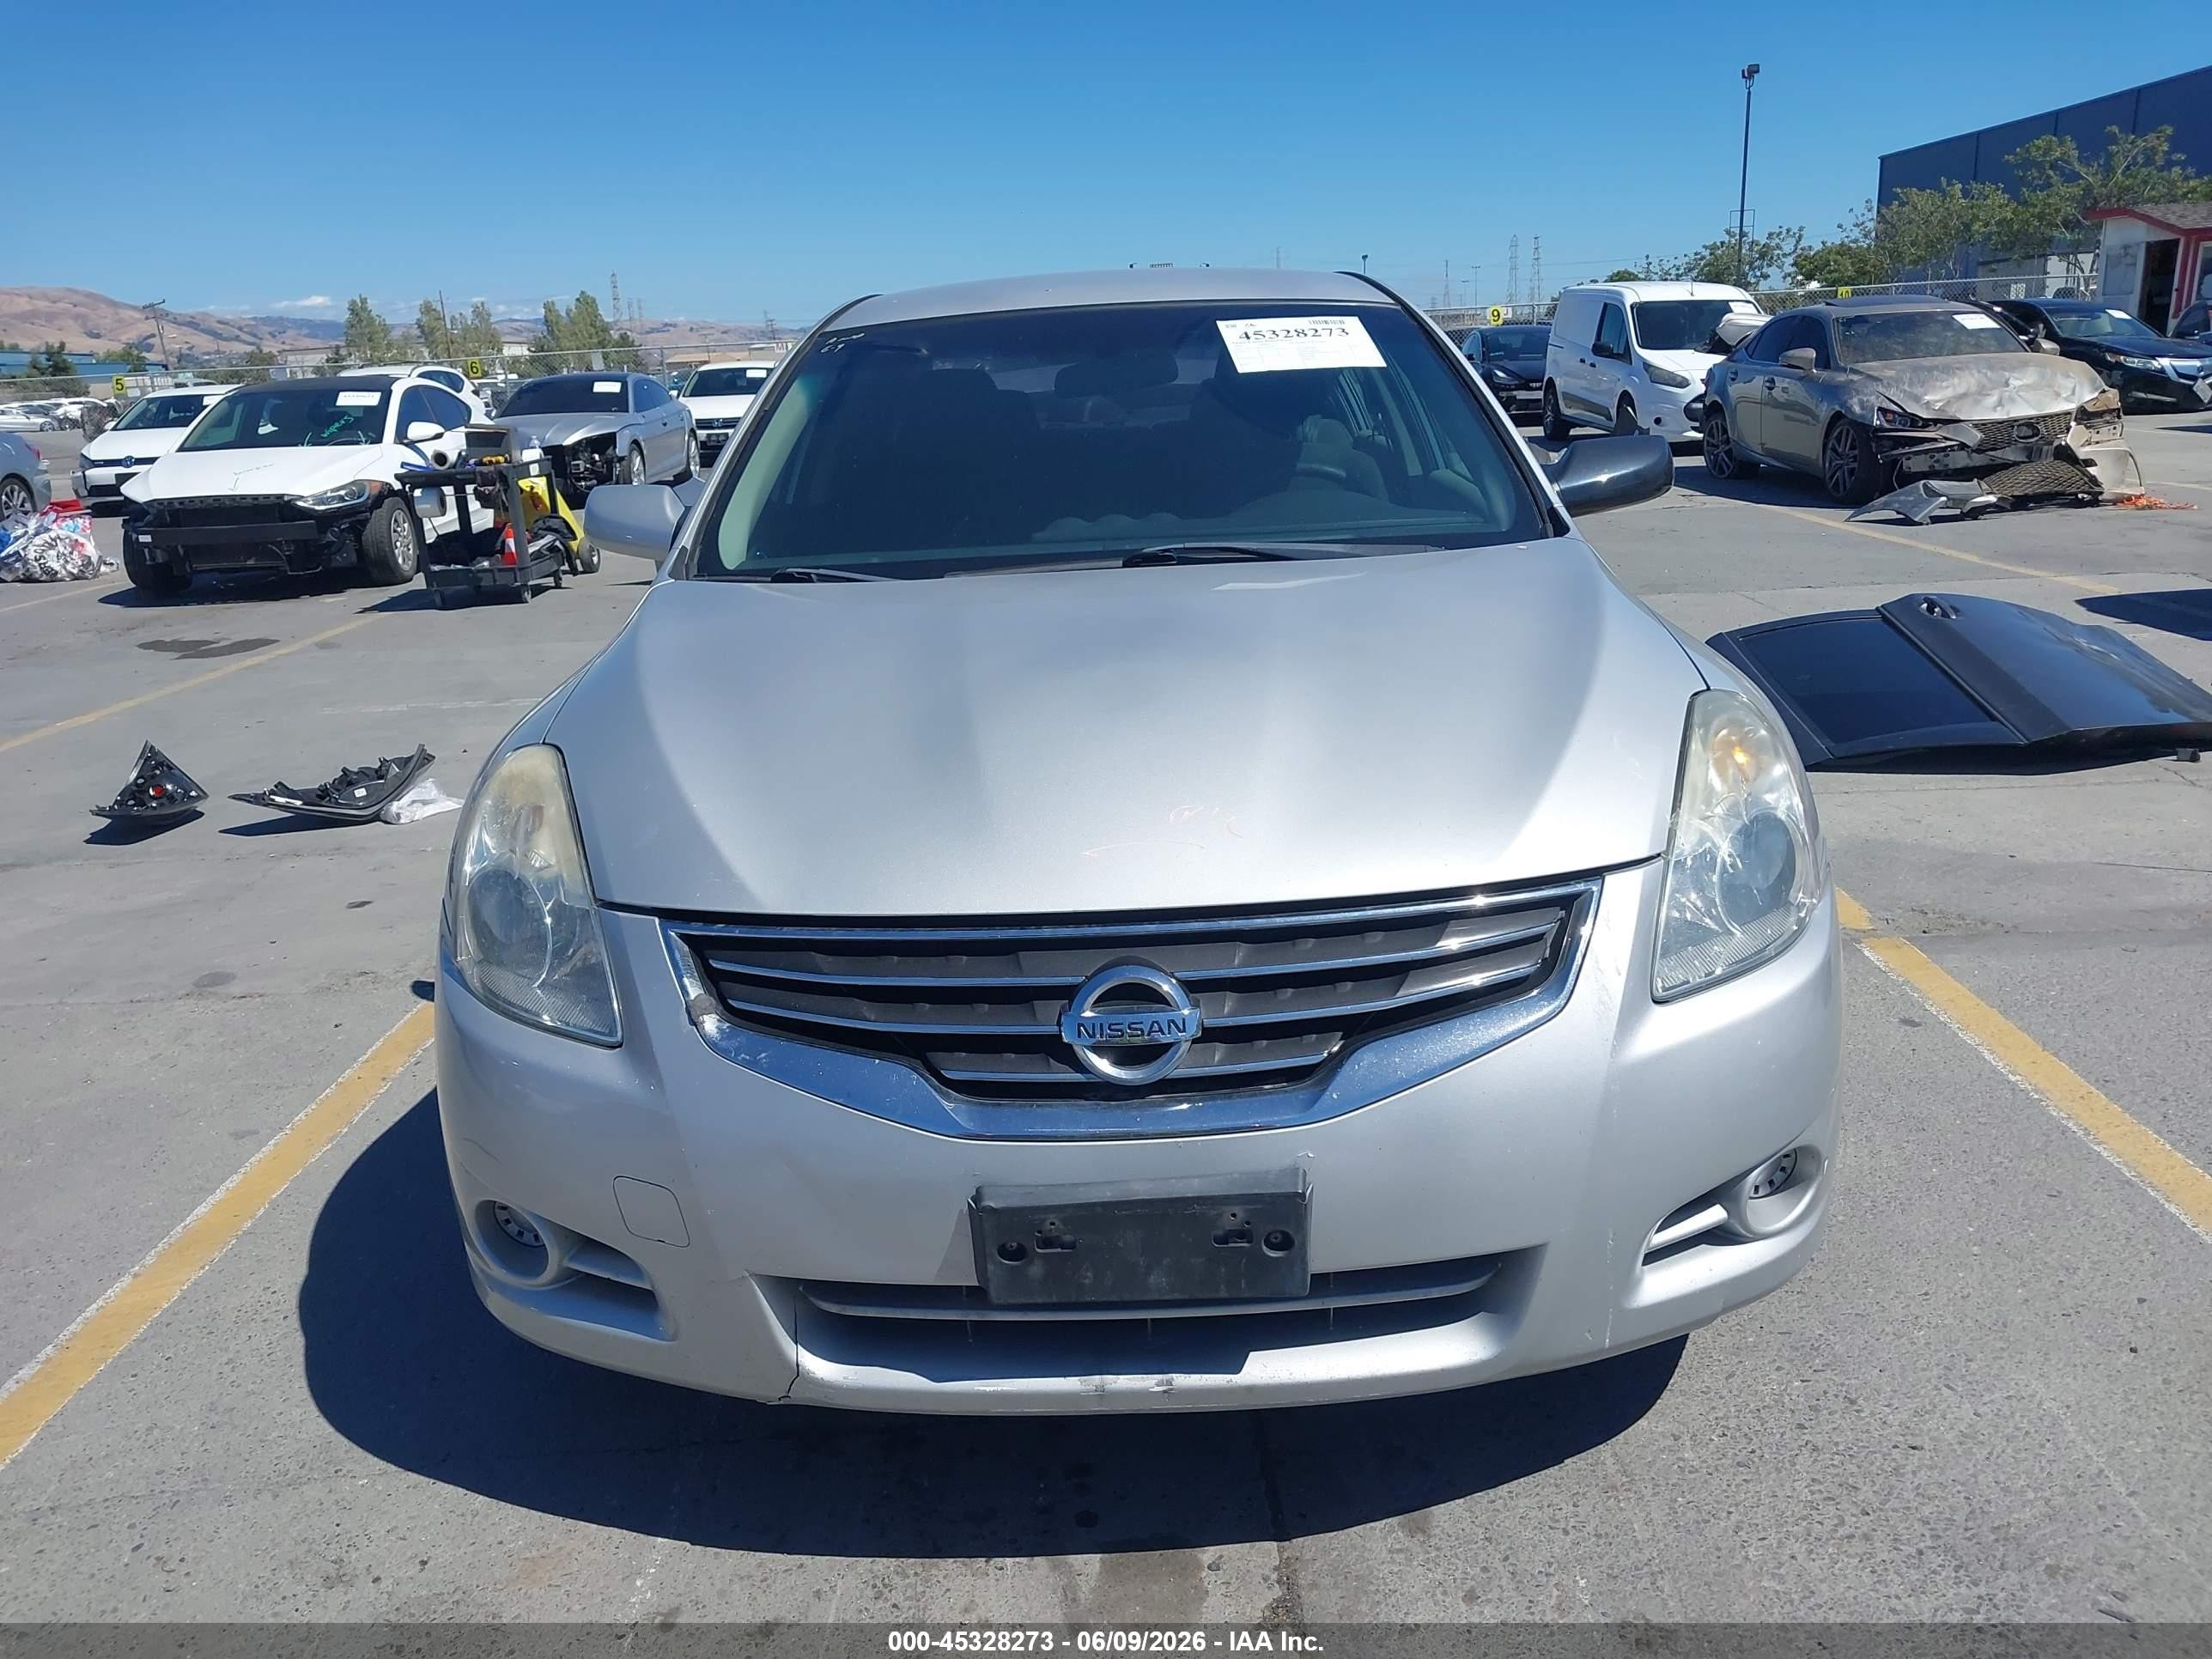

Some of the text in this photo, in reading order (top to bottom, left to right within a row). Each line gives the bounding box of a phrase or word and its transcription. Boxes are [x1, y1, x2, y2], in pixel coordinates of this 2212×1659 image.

[1492, 308, 1501, 323] 9
[1239, 327, 1349, 341] 45328273
[470, 361, 479, 374] 6
[115, 378, 125, 392] 5
[1076, 1018, 1187, 1040] NISSAN
